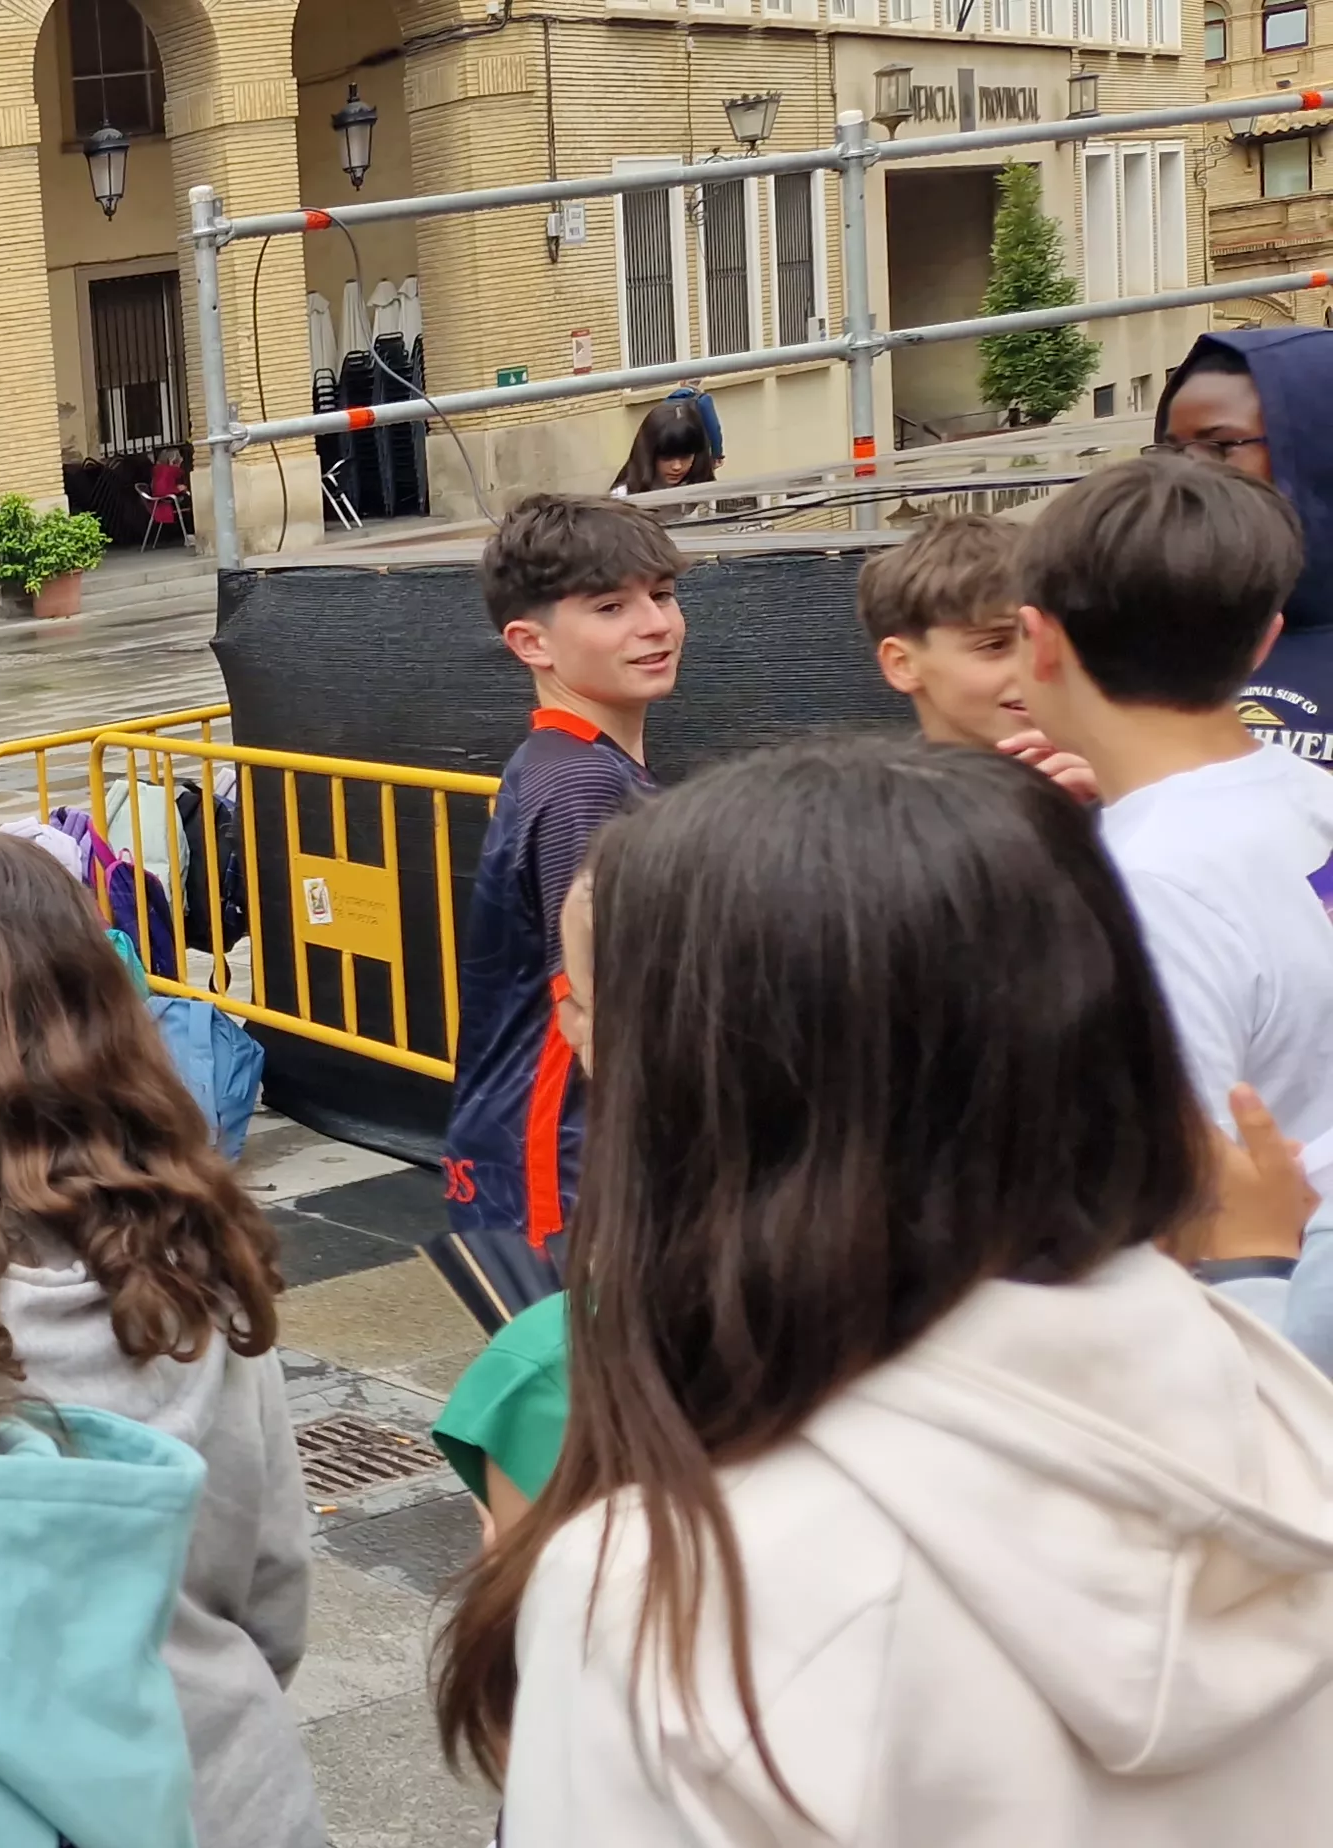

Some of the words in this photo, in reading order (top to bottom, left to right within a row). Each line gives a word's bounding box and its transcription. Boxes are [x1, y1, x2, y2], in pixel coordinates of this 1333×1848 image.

[978, 86, 1041, 122] PROVINCIAL
[1239, 686, 1273, 697] INAL
[1274, 688, 1306, 705] SURF
[1302, 700, 1318, 715] CO
